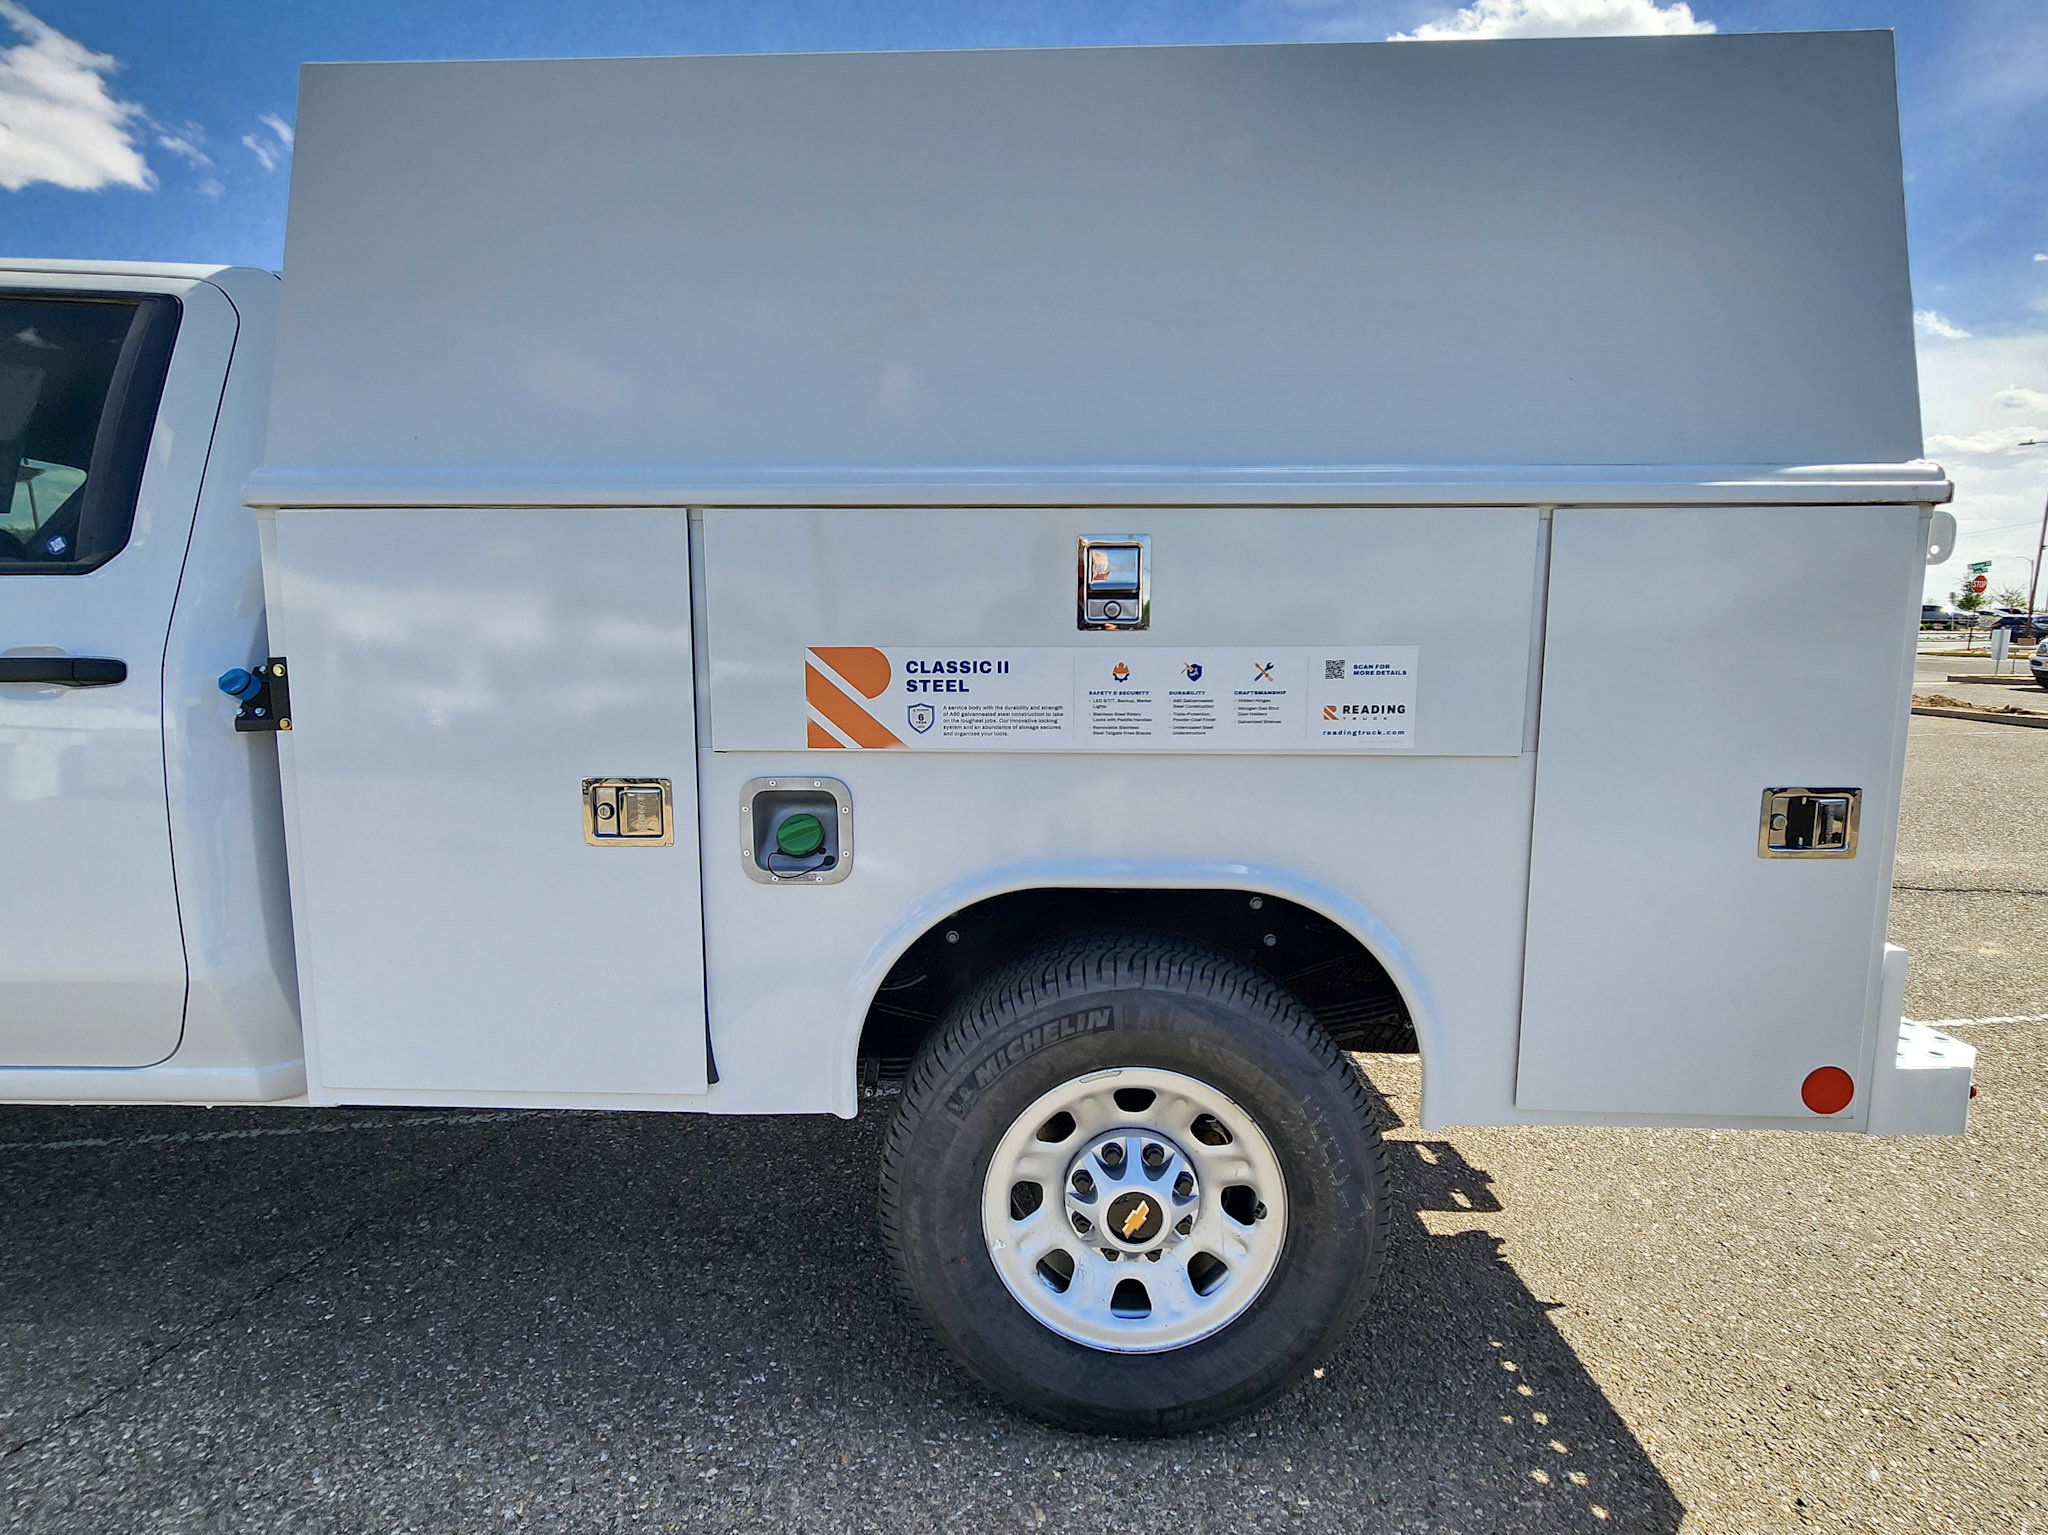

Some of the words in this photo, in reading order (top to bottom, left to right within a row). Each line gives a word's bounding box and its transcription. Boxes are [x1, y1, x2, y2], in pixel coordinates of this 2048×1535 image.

[906, 660, 992, 674] CLASSIC
[997, 660, 1009, 674] II
[906, 679, 970, 693] STEEL
[1343, 705, 1406, 714] READING
[974, 1008, 1112, 1089] MICHELIN
